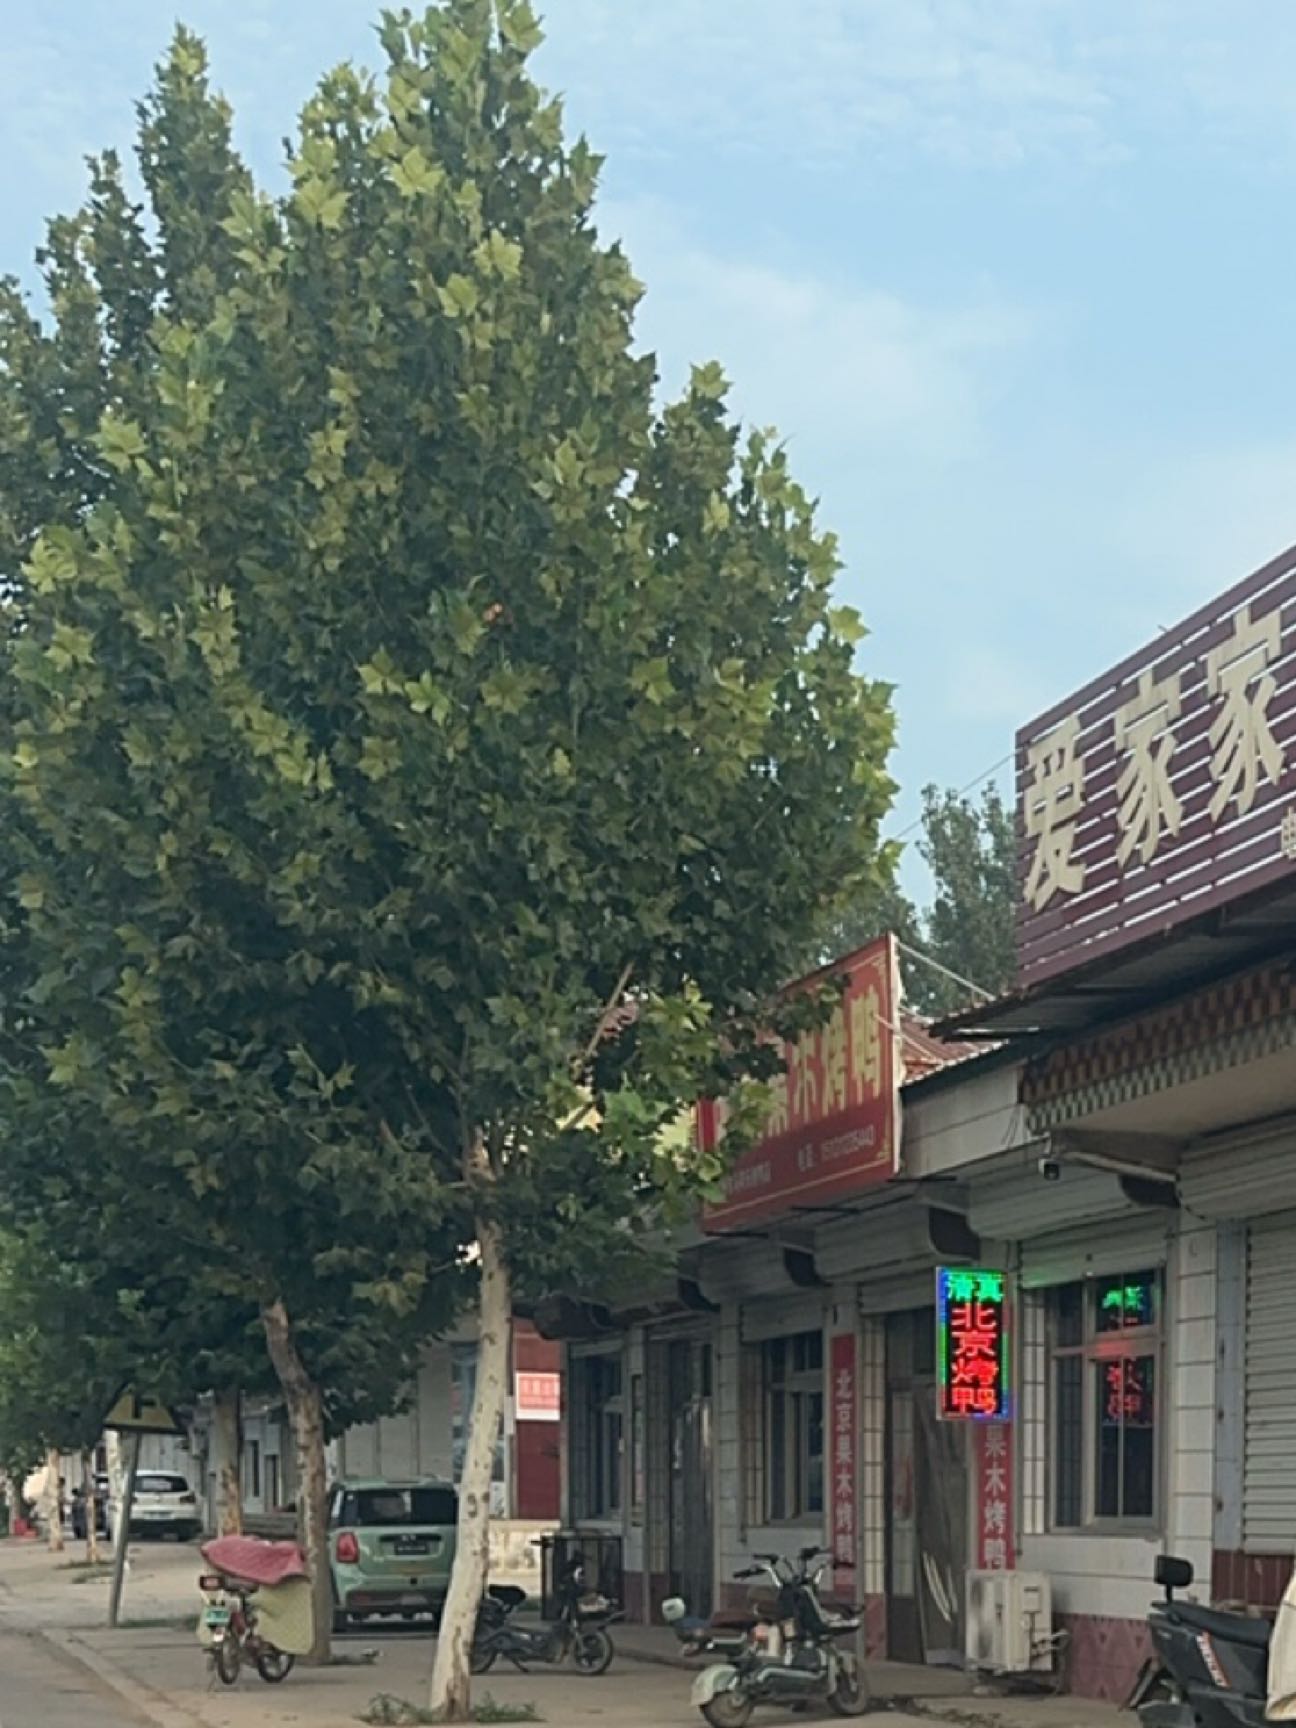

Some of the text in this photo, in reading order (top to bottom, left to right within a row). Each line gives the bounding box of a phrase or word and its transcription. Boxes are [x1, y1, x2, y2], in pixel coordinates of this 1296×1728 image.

[951, 1302, 999, 1414] 北京烤鸭
[835, 1367, 854, 1564] 北京果木烤鸭
